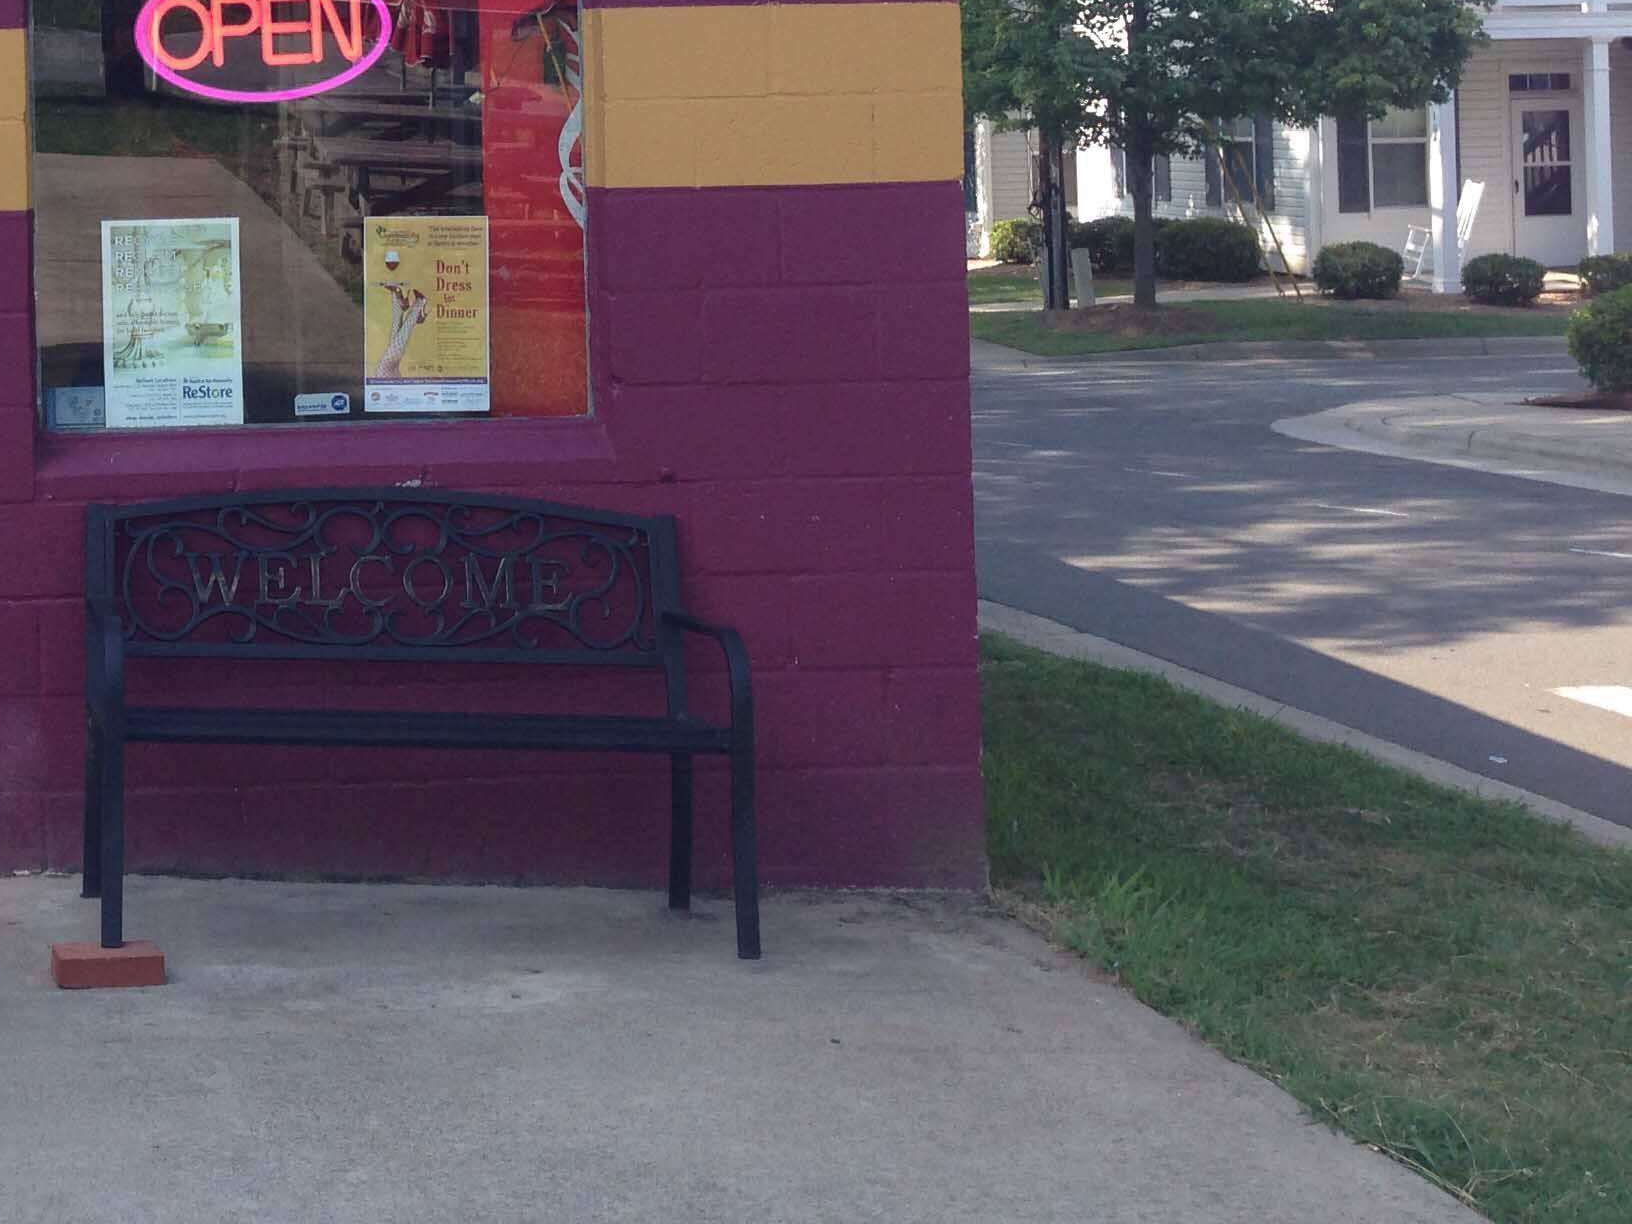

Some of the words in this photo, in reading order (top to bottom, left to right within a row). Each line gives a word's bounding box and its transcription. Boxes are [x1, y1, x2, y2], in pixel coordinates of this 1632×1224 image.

[436, 259, 470, 274] Don't
[436, 277, 472, 292] Dress
[436, 304, 478, 319] Dinner
[182, 385, 233, 399] ReStore
[186, 550, 572, 611] WELCOME
